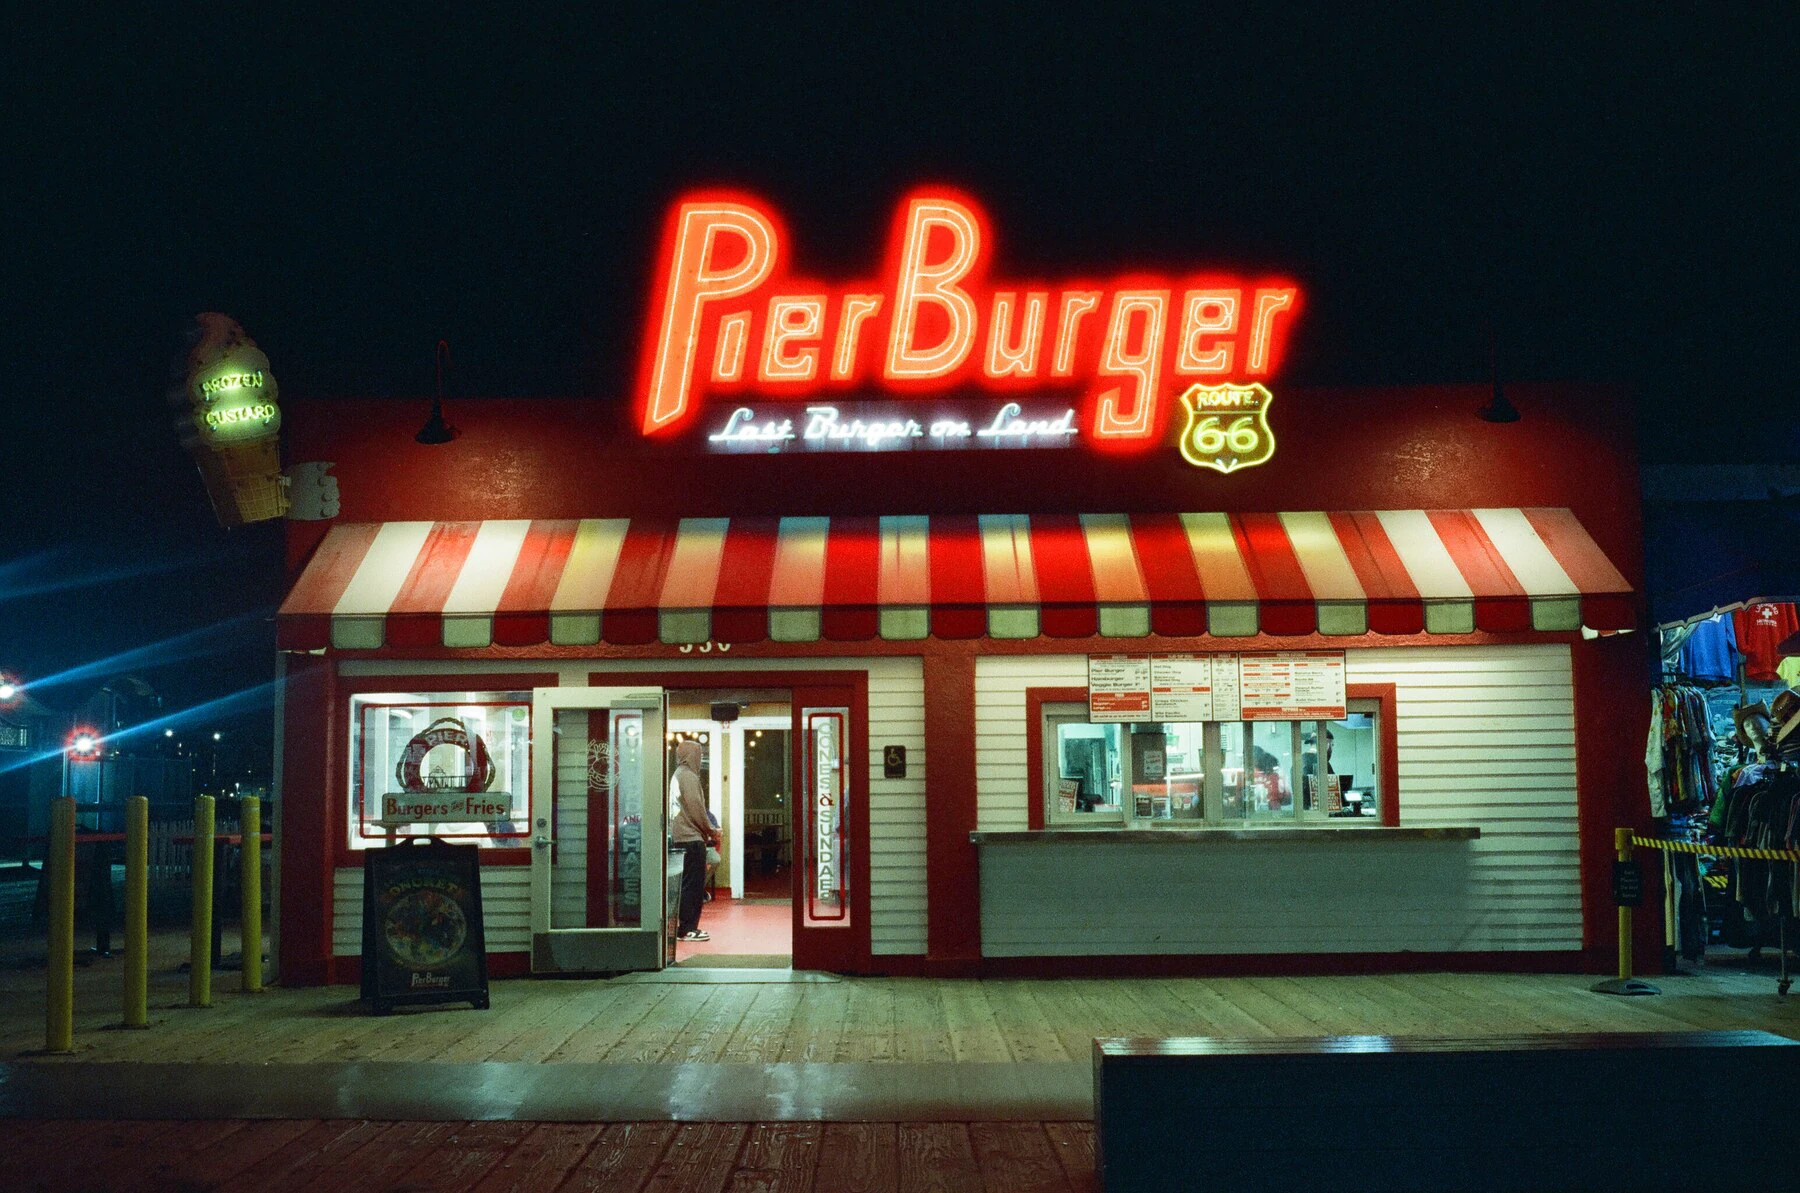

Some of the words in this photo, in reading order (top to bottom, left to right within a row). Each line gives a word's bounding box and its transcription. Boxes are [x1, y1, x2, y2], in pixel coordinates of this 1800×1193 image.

[1196, 390, 1255, 407] ROUTE
[206, 404, 275, 426] CUSTARD
[708, 407, 796, 441] Last
[803, 406, 923, 446] Burger
[929, 420, 971, 437] on
[976, 402, 1079, 437] Land
[1192, 416, 1260, 454] 66
[425, 730, 468, 746] PIER
[818, 722, 832, 789] CONES
[386, 797, 448, 819] Burgers
[466, 797, 505, 815] Fries
[819, 793, 834, 806] &
